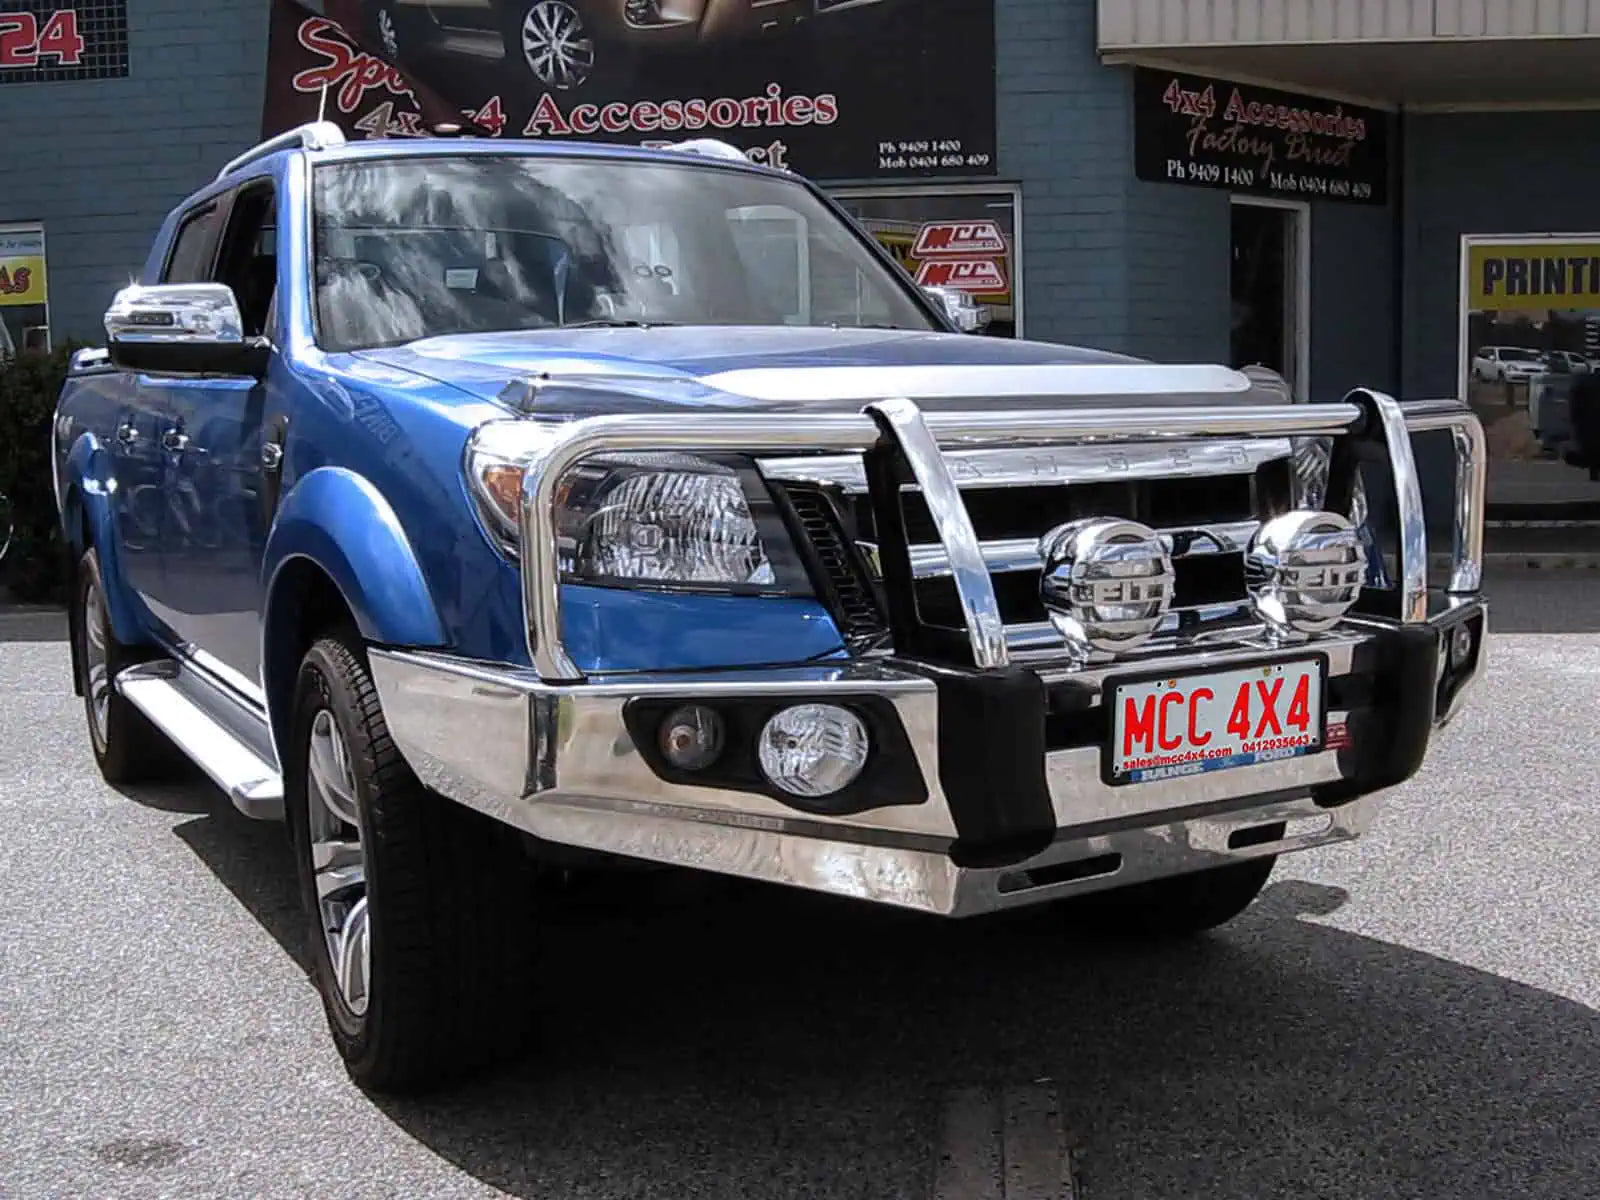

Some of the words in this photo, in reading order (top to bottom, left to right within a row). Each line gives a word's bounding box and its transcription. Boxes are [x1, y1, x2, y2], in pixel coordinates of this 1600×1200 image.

[0, 10, 84, 68] 24
[522, 83, 838, 136] Accessories
[1162, 78, 1216, 118] 4x4
[1223, 87, 1367, 141] Accessories
[1167, 159, 1185, 178] Ph
[1188, 162, 1220, 181] 9409
[1224, 166, 1254, 185] 1400
[1270, 171, 1297, 190] Mob
[1122, 687, 1214, 757] MCC
[1226, 673, 1310, 741] 4X4
